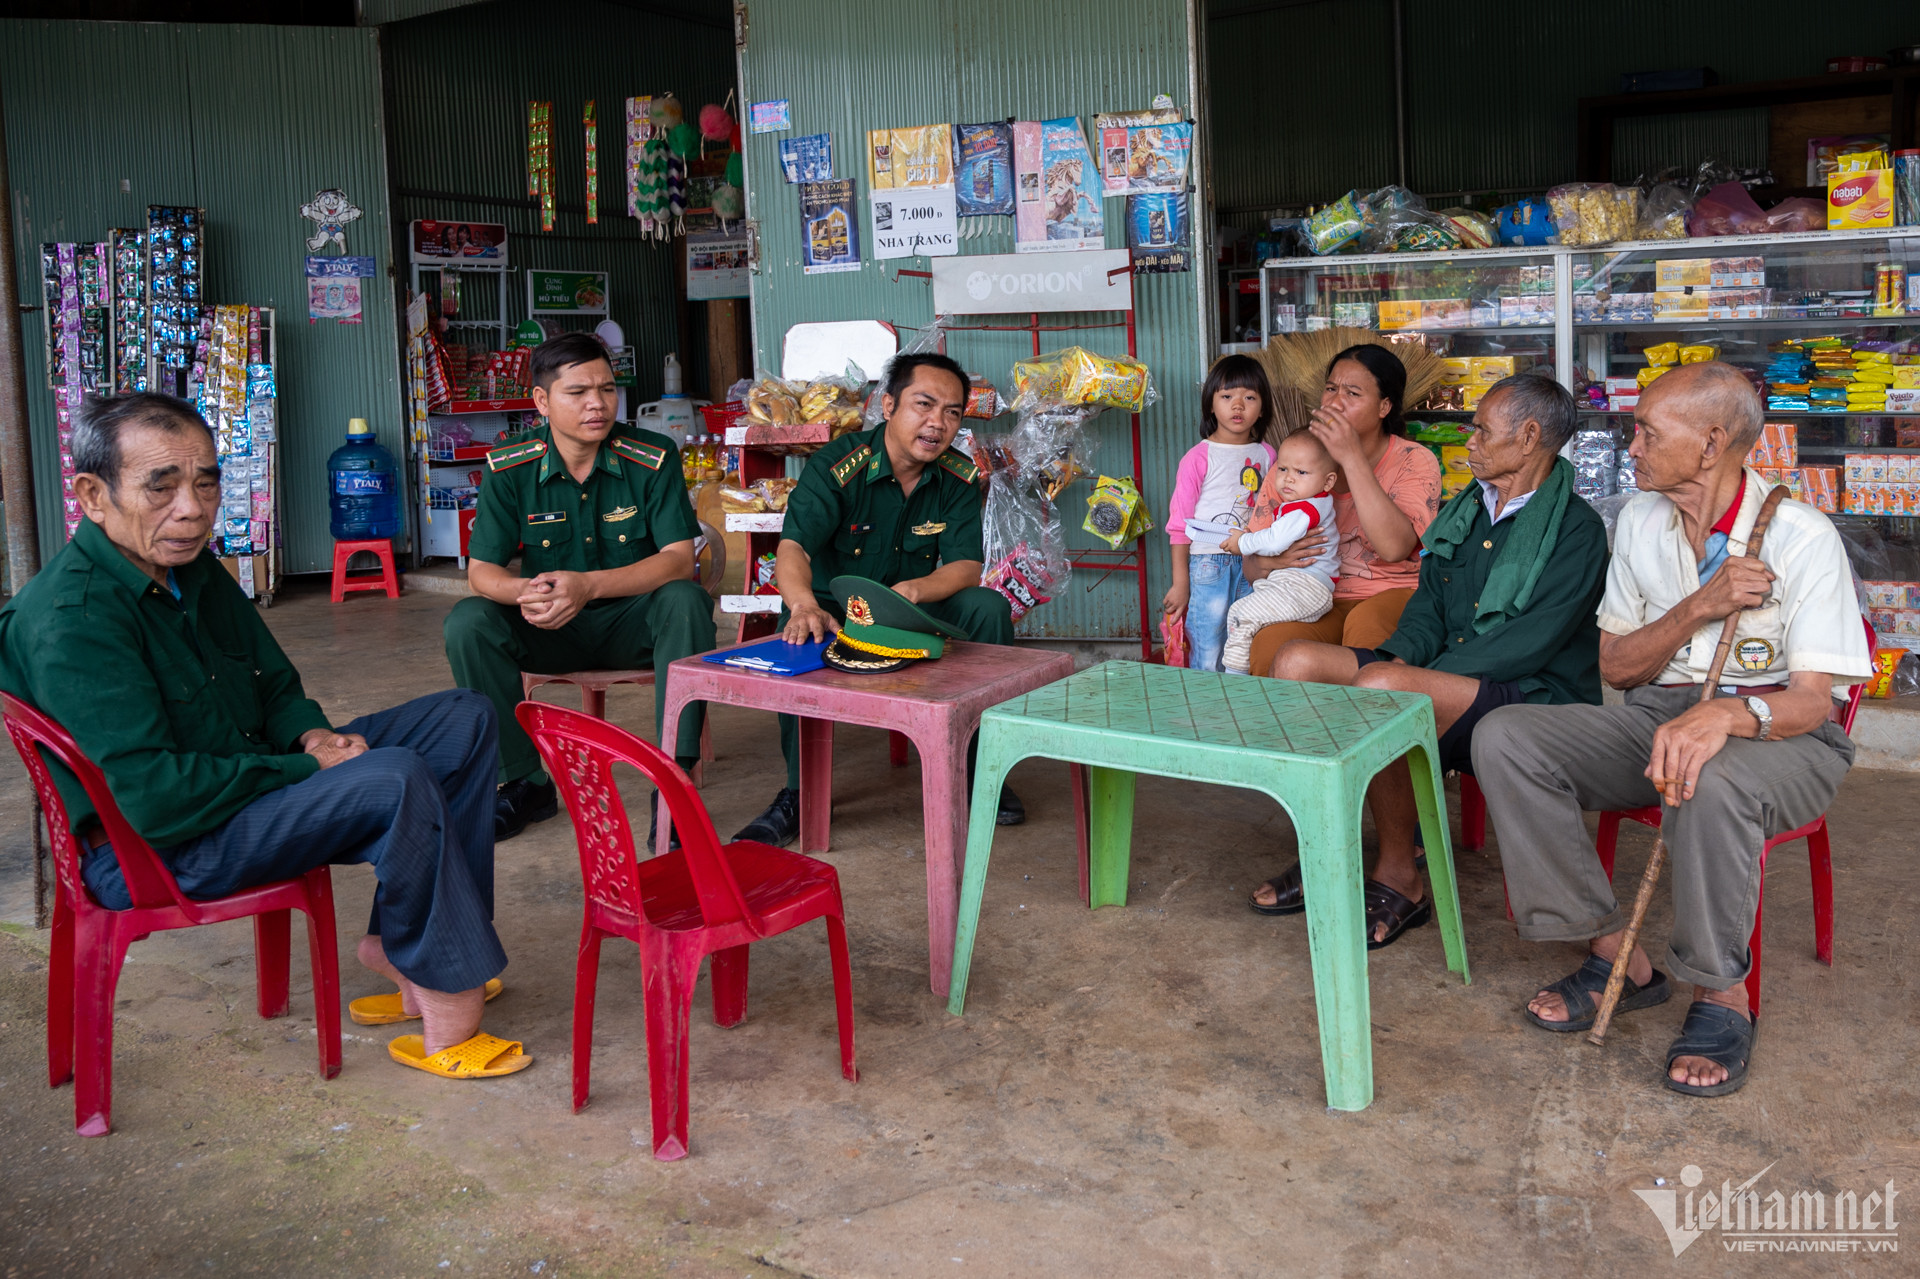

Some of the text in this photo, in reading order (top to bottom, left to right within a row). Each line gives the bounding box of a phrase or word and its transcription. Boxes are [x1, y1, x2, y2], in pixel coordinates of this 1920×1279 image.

[1832, 186, 1863, 199] nabati
[900, 206, 935, 221] 7.000
[878, 233, 952, 249] NHA TRANG
[999, 271, 1083, 295] ORION
[538, 293, 570, 302] HỦ TIẾU
[1889, 392, 1914, 402] Potato
[1006, 577, 1036, 608] POCA
